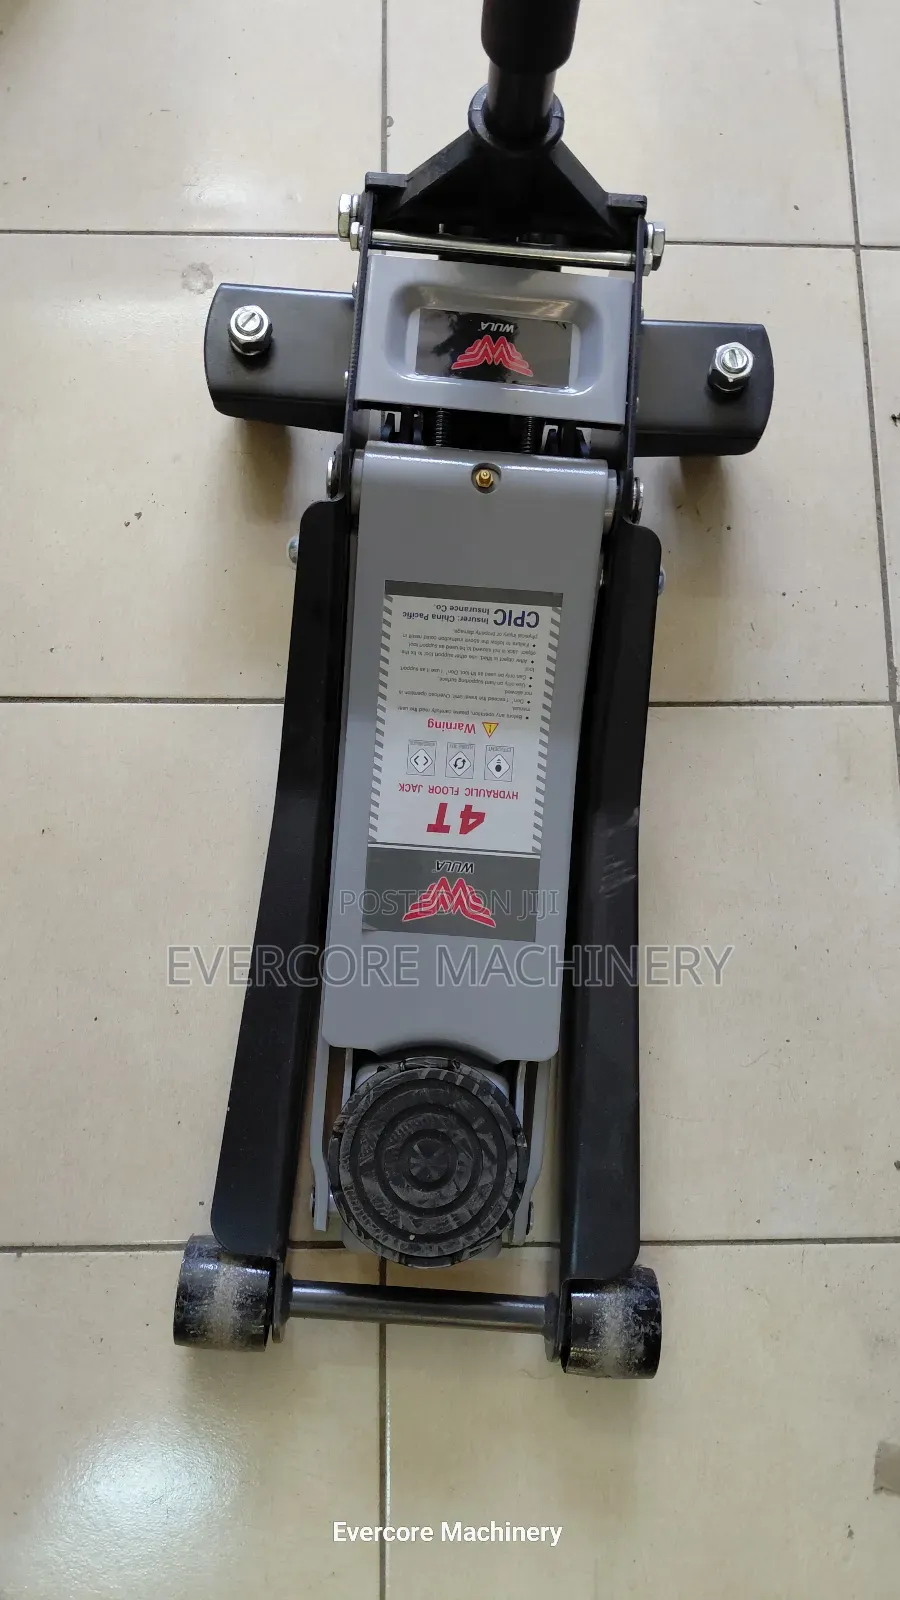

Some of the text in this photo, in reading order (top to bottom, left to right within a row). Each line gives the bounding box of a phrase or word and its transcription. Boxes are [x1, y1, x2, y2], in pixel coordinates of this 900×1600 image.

[480, 321, 514, 333] WULA
[433, 604, 489, 615] Insurance Co.
[403, 612, 488, 624] Insurer: China Pacific
[493, 609, 539, 628] CPIC
[427, 719, 476, 734] Warning
[398, 782, 519, 800] HYDRAULIC FLOOR JACK
[435, 860, 475, 874] WULA
